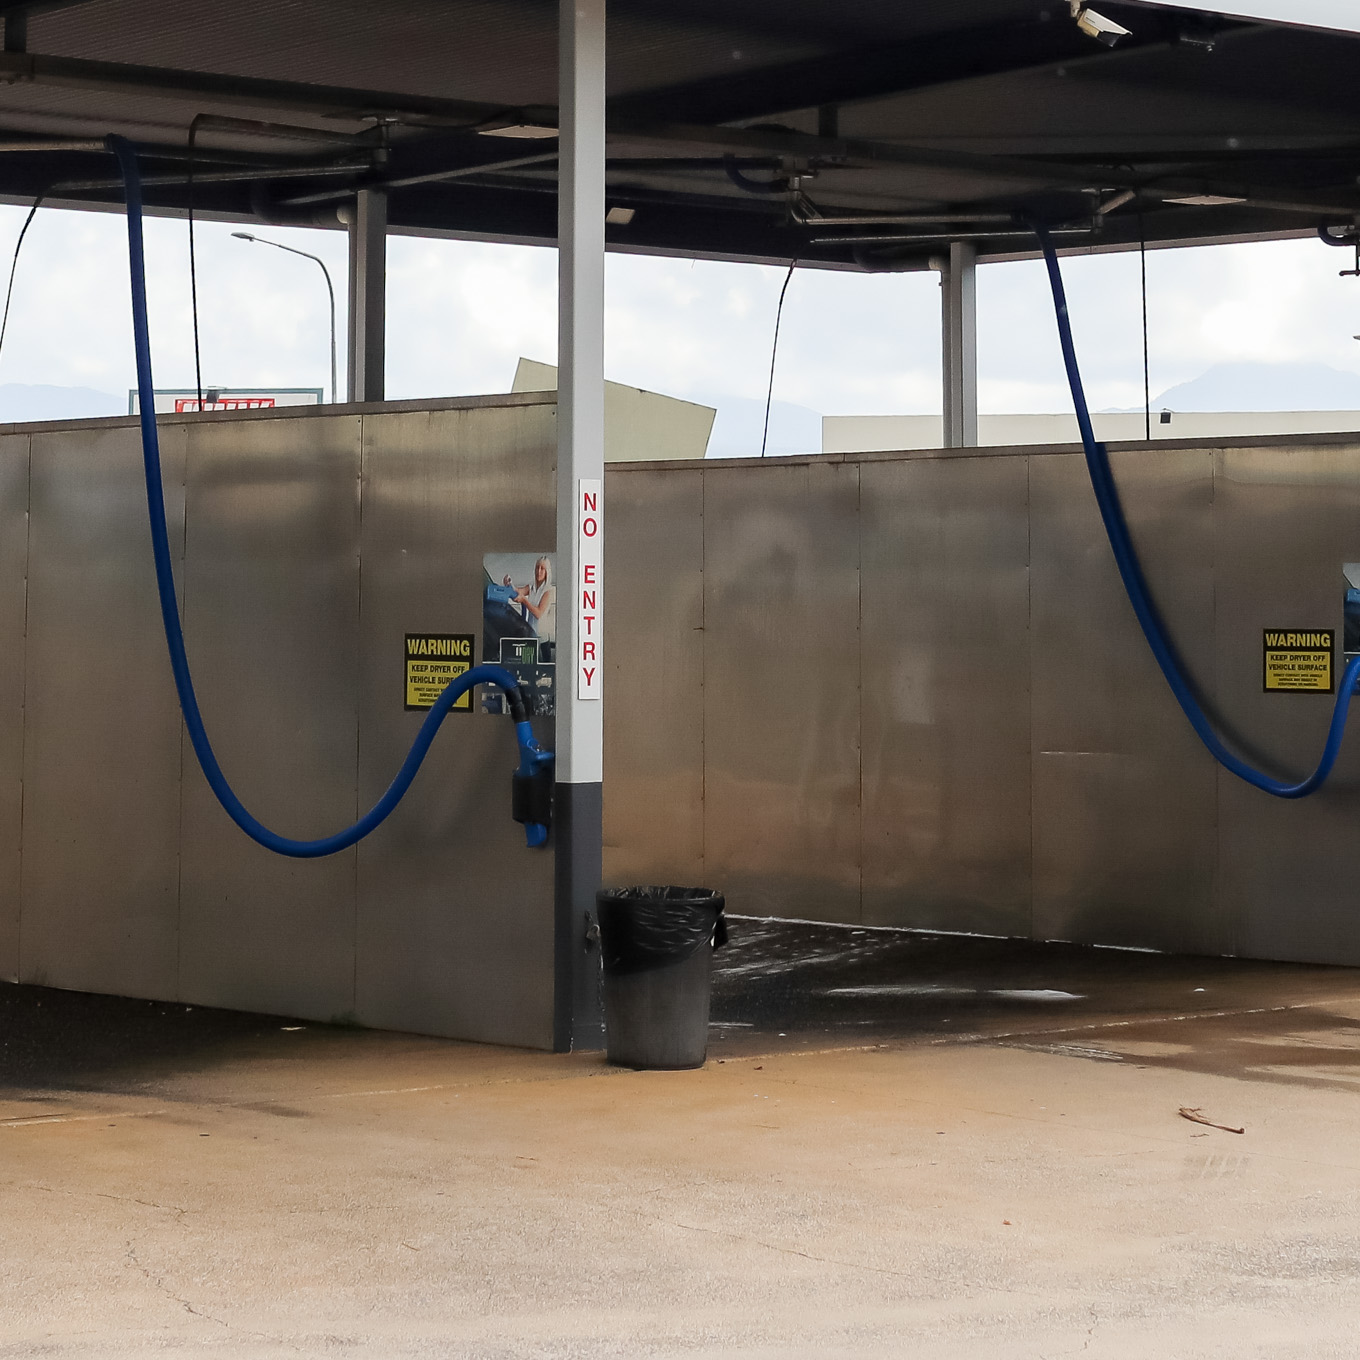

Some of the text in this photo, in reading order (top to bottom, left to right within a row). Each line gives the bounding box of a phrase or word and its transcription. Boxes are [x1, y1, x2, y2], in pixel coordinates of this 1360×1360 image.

[582, 492, 597, 687] NO ENTRY
[407, 638, 471, 656] WARNING
[1265, 633, 1331, 647] WARNING
[411, 664, 466, 673] KEEP DRYER OFF
[409, 676, 436, 684] VEHICLE
